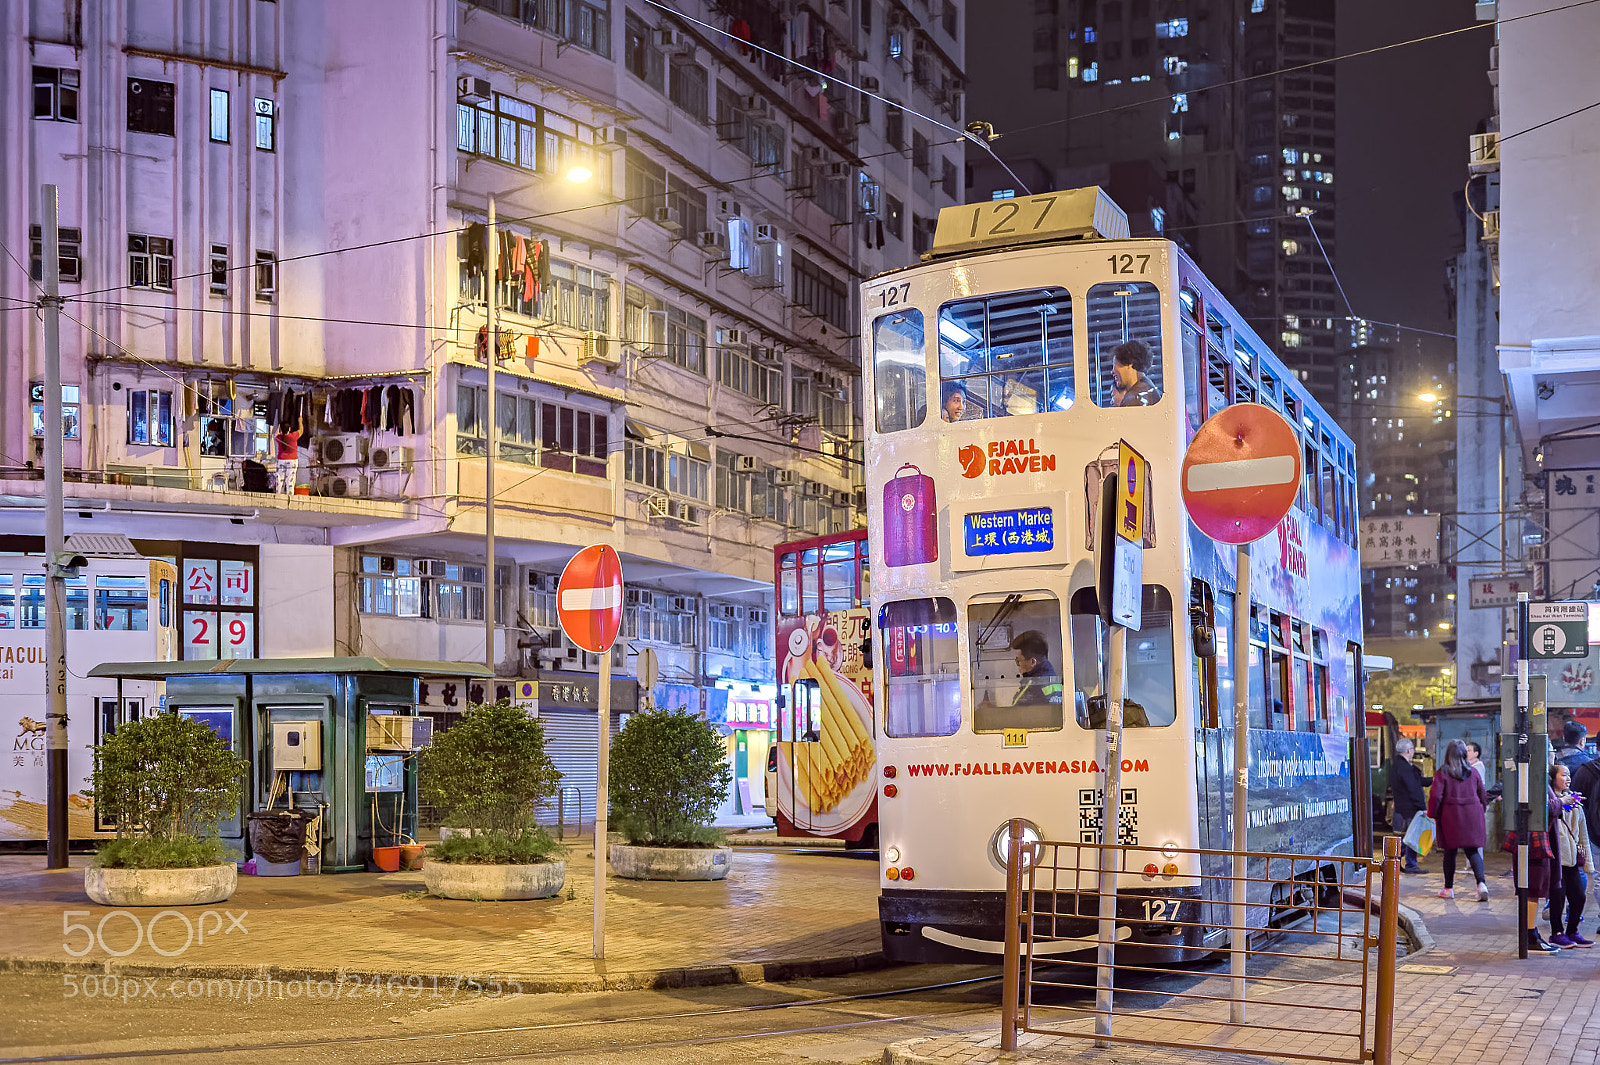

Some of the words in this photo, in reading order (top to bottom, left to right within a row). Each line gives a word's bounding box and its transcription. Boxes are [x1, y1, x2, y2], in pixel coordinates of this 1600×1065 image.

[969, 196, 1058, 238] 127
[1107, 254, 1151, 275] 127
[878, 282, 911, 308] 127
[971, 514, 1014, 529] Western
[187, 566, 250, 594] 公司
[1006, 733, 1025, 743] 111
[907, 759, 1150, 777] WWW.FJALLRAVENASIA.OM
[1141, 899, 1182, 921] 127
